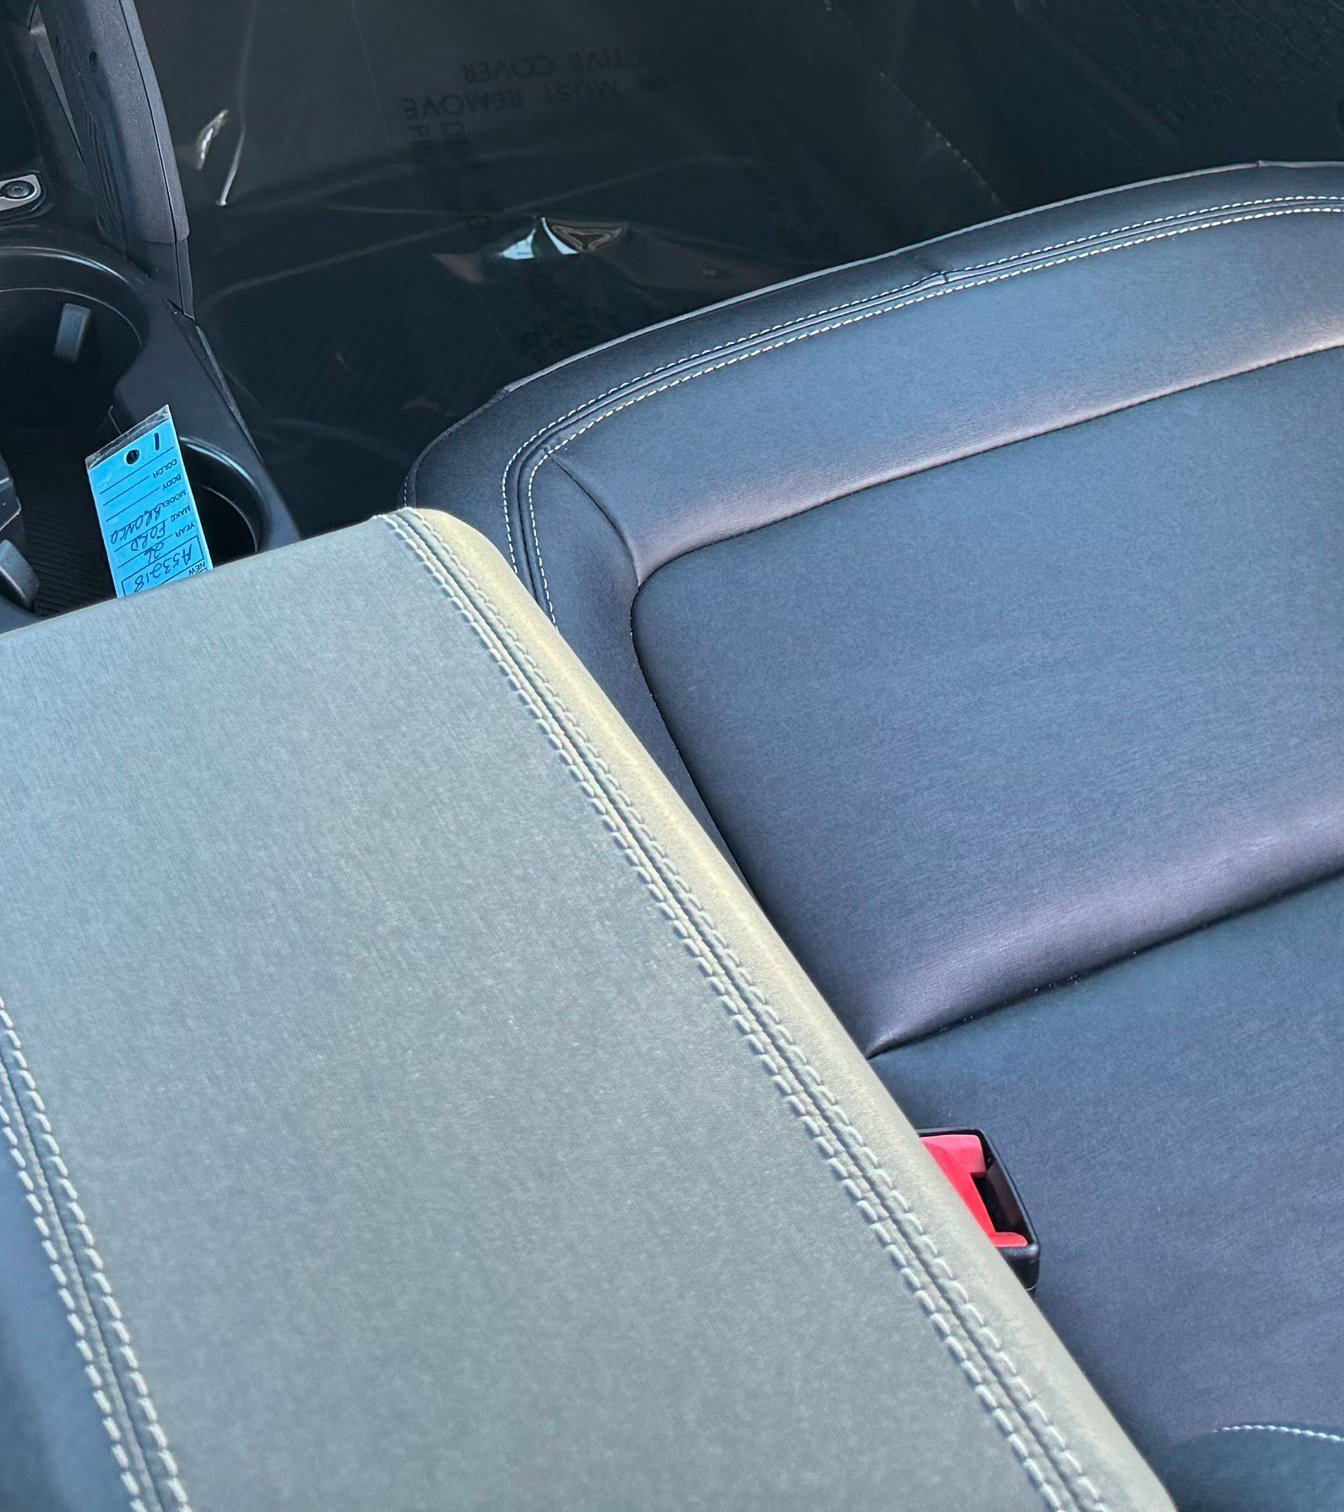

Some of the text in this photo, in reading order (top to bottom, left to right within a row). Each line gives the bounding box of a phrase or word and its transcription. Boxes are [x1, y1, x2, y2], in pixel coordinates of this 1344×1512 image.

[461, 55, 555, 83] COVER
[402, 88, 524, 120] REMOVE
[153, 459, 177, 477] COLOR
[162, 473, 182, 490] BODY
[170, 505, 191, 523] MAKE
[131, 521, 166, 552] FORD
[175, 522, 195, 538] YEAR
[188, 561, 206, 576] NEW
